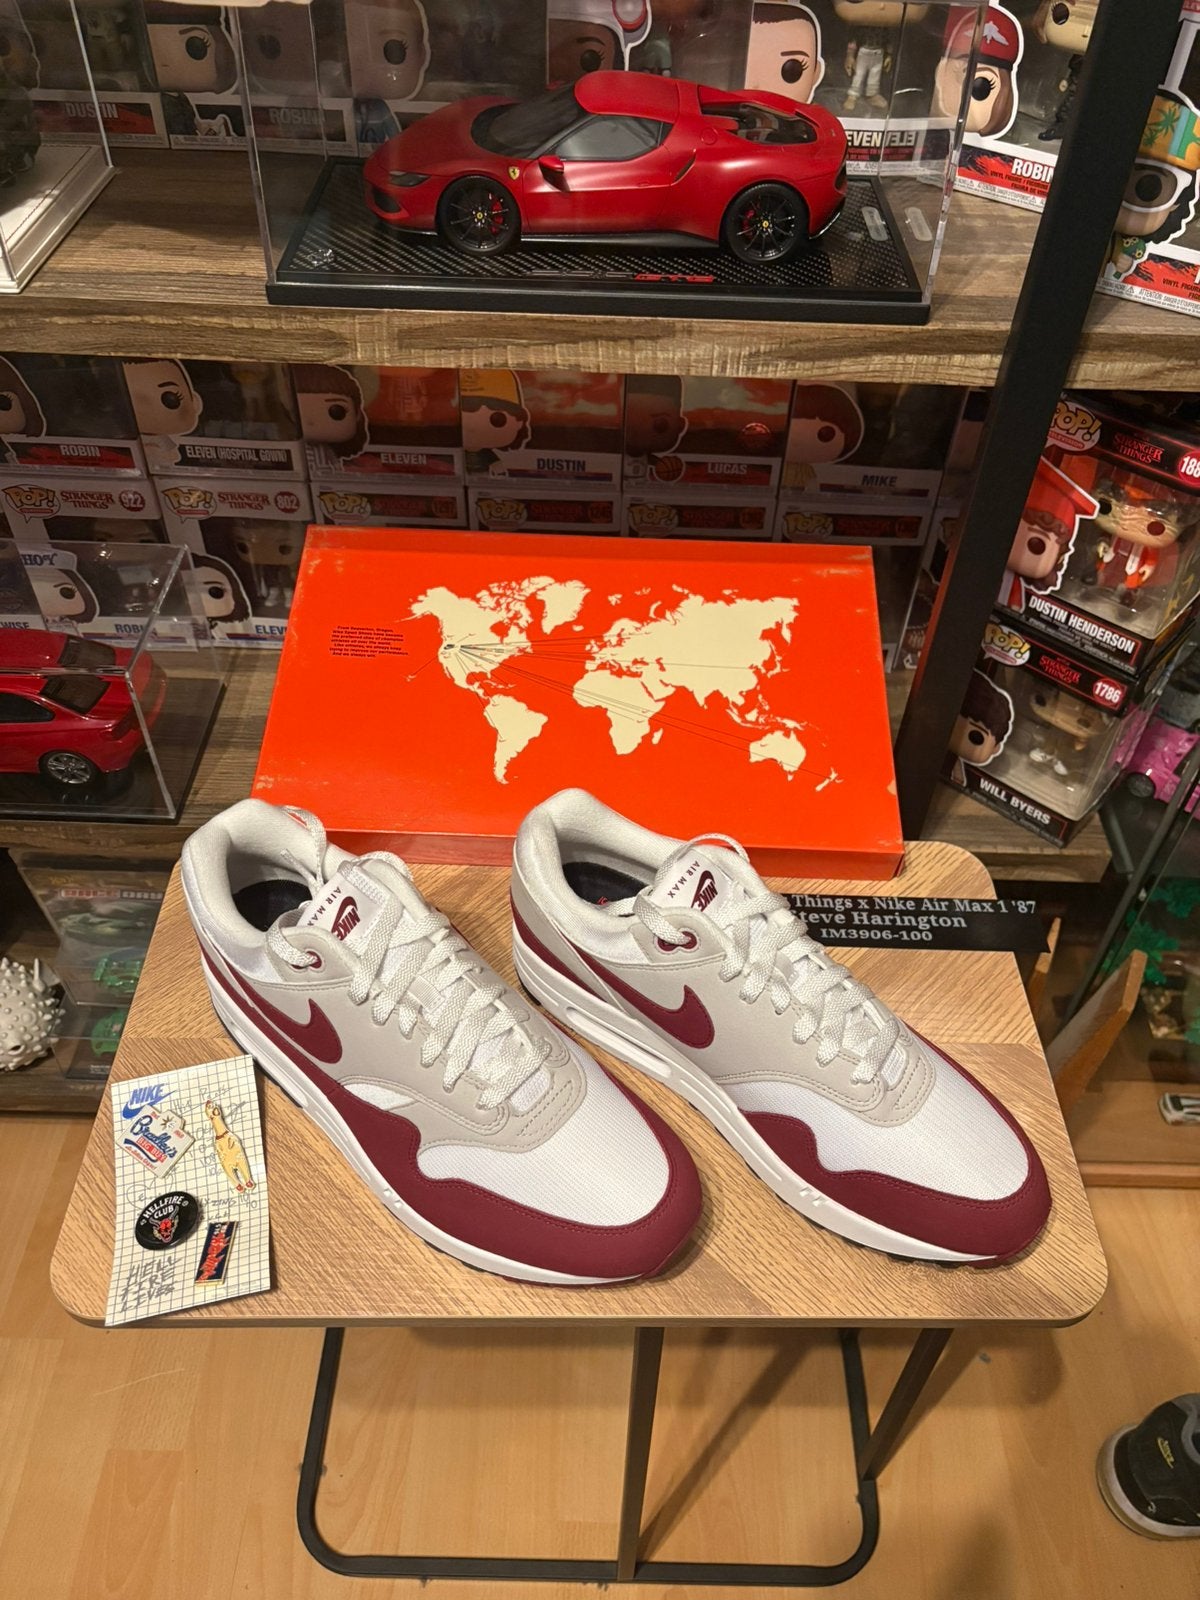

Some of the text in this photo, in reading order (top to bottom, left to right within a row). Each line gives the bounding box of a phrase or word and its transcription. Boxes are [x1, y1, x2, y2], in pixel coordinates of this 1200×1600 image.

[65, 102, 119, 119] DUSIN
[845, 130, 883, 147] EVEN
[1048, 430, 1085, 449] ELEVISION
[1113, 431, 1164, 462] STRANGER
[60, 444, 101, 457] ROBIN
[185, 445, 288, 462] ELEVEN (HOSPITAL GOWN)
[380, 453, 427, 465] ELEVEN
[1119, 445, 1152, 464] THINGS
[536, 458, 586, 472] DUSTIN
[707, 462, 748, 475] LUCAS
[861, 474, 898, 487] MIKE
[2, 485, 56, 508] POP!
[60, 491, 115, 504] STRANGER
[72, 500, 109, 510] THINGS
[121, 491, 144, 508] 922
[161, 487, 213, 510] POP!
[218, 492, 271, 506] STRANGER
[229, 501, 263, 511] THINGS
[277, 495, 298, 509] 802
[319, 491, 368, 514] POP!
[475, 498, 527, 521] POP!
[20, 551, 58, 566] HOY
[114, 623, 147, 634] ROBI
[255, 624, 288, 635] ELEV
[1028, 595, 1136, 655] DUSTIN HENDERSON
[984, 622, 1031, 659] POP!
[1094, 681, 1122, 704] 1786
[979, 777, 1051, 825] WILL BYERS
[667, 860, 700, 899] AIR MAX
[325, 886, 342, 905] AIR
[697, 881, 718, 912] NIKE
[791, 894, 1037, 914] Things x Nike Air Max 1 '87
[336, 906, 361, 941] NIKE
[790, 910, 967, 930] teve Harington
[820, 928, 933, 942] IM3906-100
[130, 1083, 165, 1106] NIKE
[130, 1114, 177, 1158] Bradley's
[138, 1137, 151, 1152] BIG
[151, 1148, 167, 1163] BUY
[143, 1195, 185, 1219] HELLFIRE
[153, 1204, 174, 1219] CLUB
